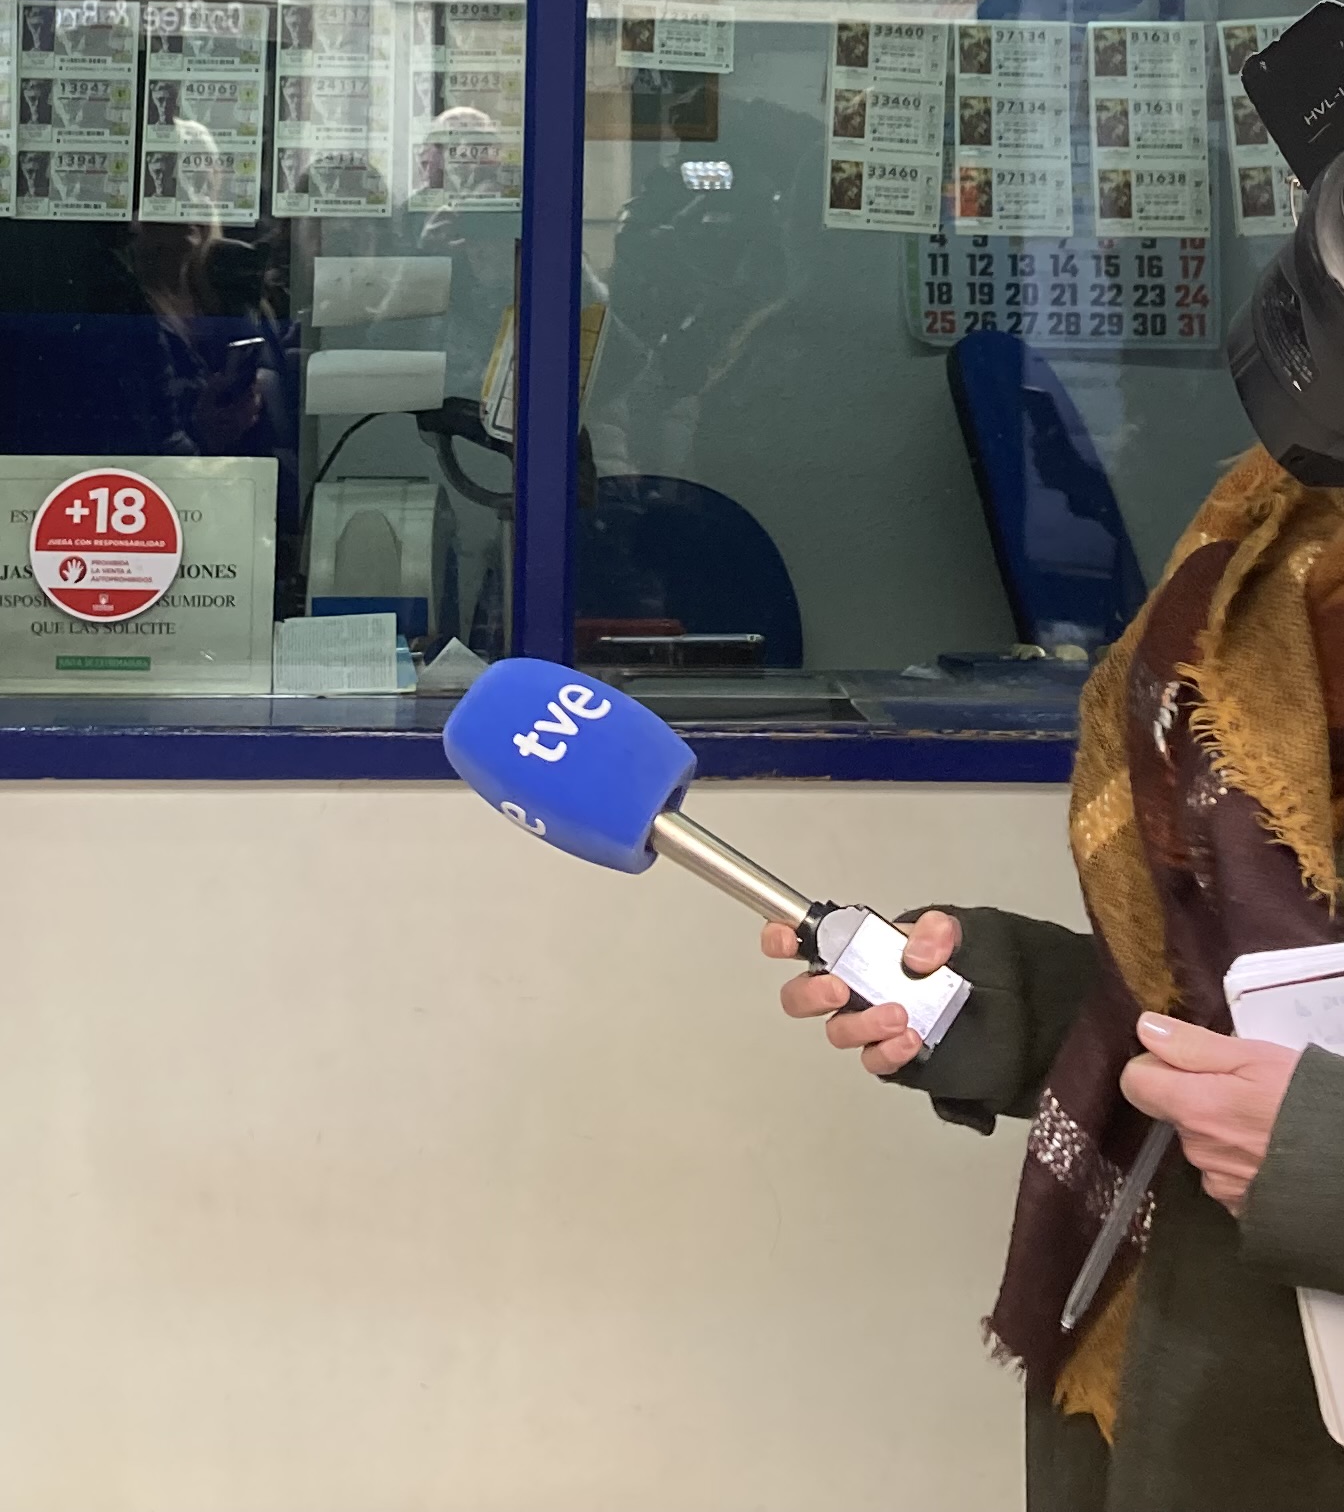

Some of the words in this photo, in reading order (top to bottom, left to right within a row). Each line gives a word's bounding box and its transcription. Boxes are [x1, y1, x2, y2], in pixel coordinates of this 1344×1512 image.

[449, 3, 502, 15] 82043
[872, 25, 925, 38] 33460
[995, 31, 1047, 43] 97134
[58, 81, 111, 95] 13947
[184, 83, 239, 96] 40969
[870, 95, 922, 109] 33460
[996, 101, 1047, 113] 97134
[56, 153, 108, 167] 13947
[867, 165, 919, 179] 33460
[996, 173, 1048, 184] 97134
[927, 253, 950, 277] 11
[966, 253, 995, 277] 12
[1007, 253, 1036, 277] 13
[1050, 254, 1080, 277] 14
[1091, 254, 1121, 278] 15
[1135, 254, 1164, 278] 16
[1179, 255, 1206, 279] 17
[925, 281, 953, 306] 18
[967, 282, 995, 306] 19
[1006, 282, 1039, 306] 20
[1050, 283, 1079, 307] 21
[1089, 283, 1123, 307] 22
[1132, 284, 1167, 308] 23
[1175, 284, 1210, 309] 24
[924, 310, 956, 335] 25
[964, 311, 998, 333] 26
[1006, 311, 1039, 336] 27
[1048, 312, 1082, 336] 28
[1089, 312, 1123, 337] 29
[1132, 312, 1167, 337] 30
[1177, 313, 1207, 337] 31
[65, 487, 147, 534] +18
[47, 538, 73, 546] JUEGA
[75, 538, 92, 546] CON
[94, 539, 166, 548] RESPONSABILIDAD
[31, 621, 66, 636] QUE
[69, 621, 99, 634] LAS
[105, 621, 176, 635] SOLICITE
[513, 683, 612, 763] tve
